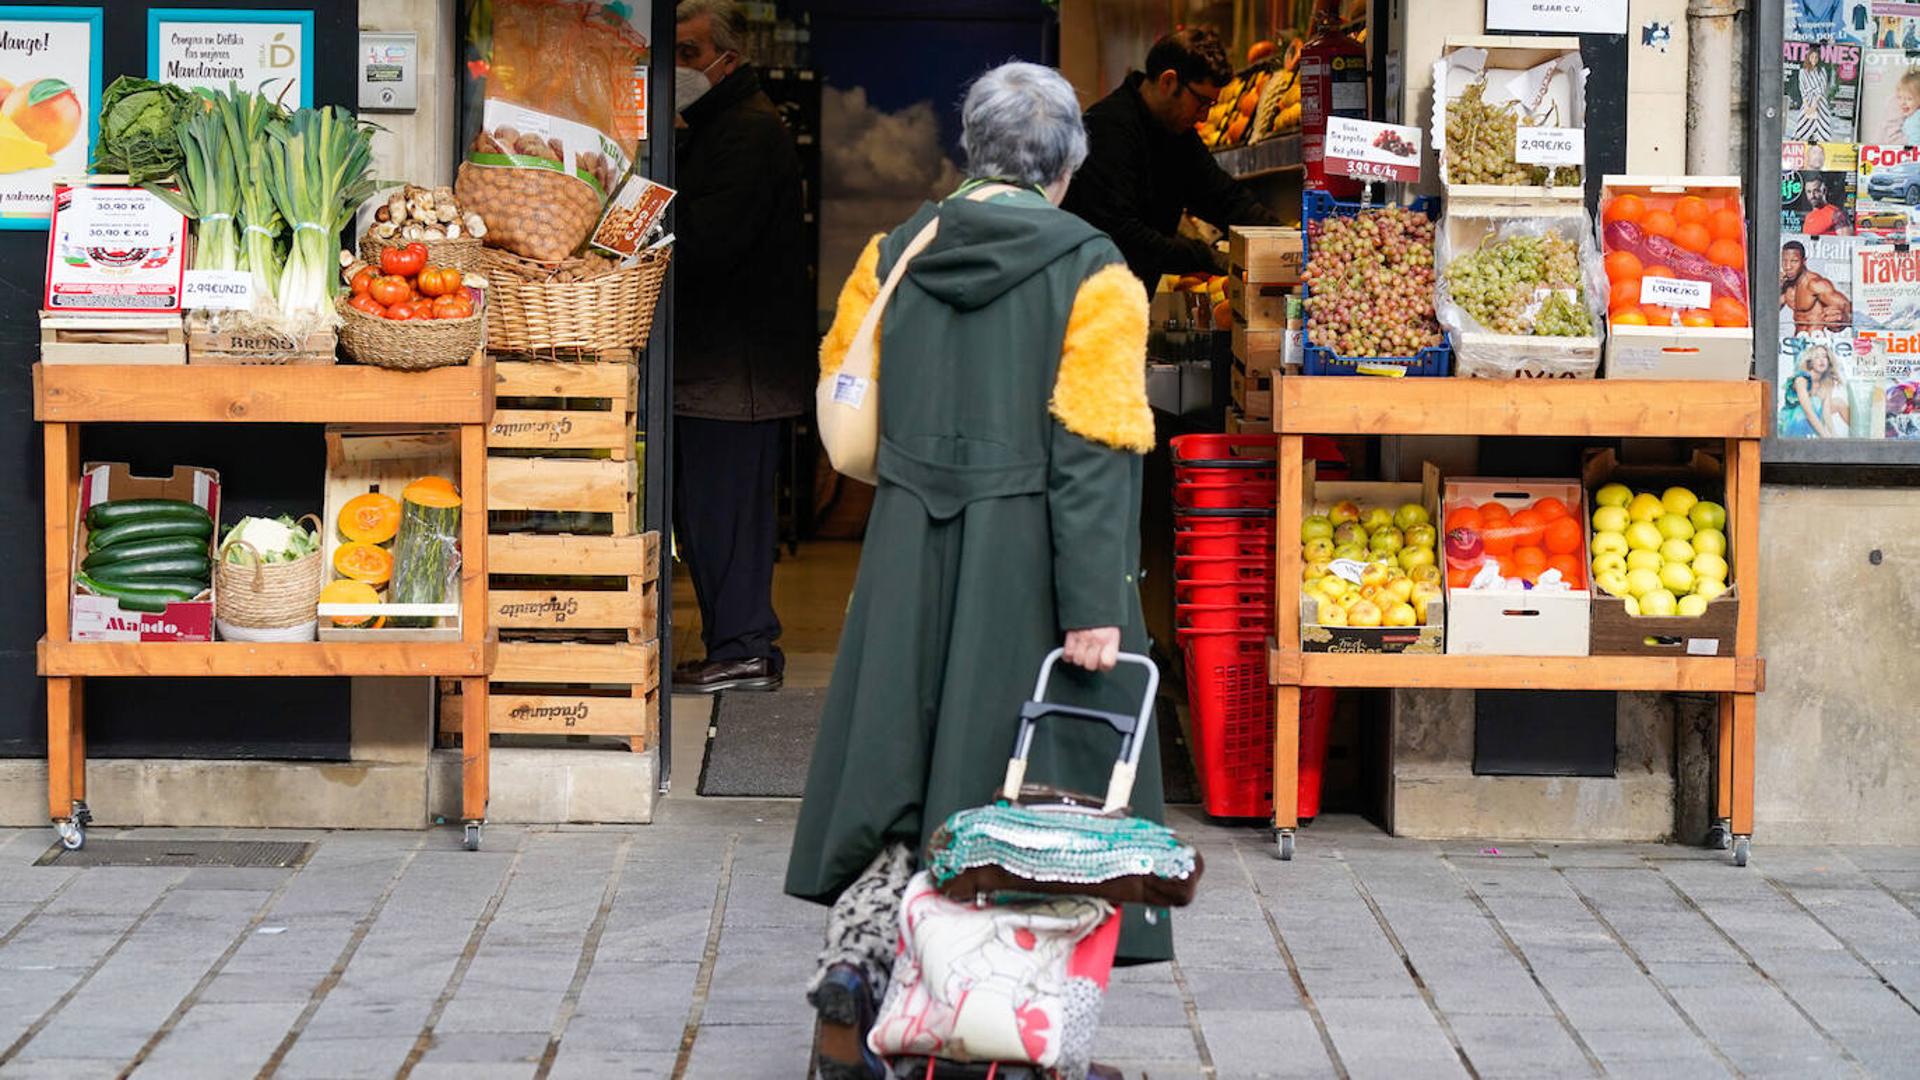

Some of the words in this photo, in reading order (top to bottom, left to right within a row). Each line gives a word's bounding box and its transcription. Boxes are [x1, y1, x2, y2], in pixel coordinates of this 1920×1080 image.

[1532, 4, 1562, 12] DEJAR
[166, 60, 245, 79] Mandarinas
[131, 203, 146, 211] KG
[134, 228, 150, 238] KG
